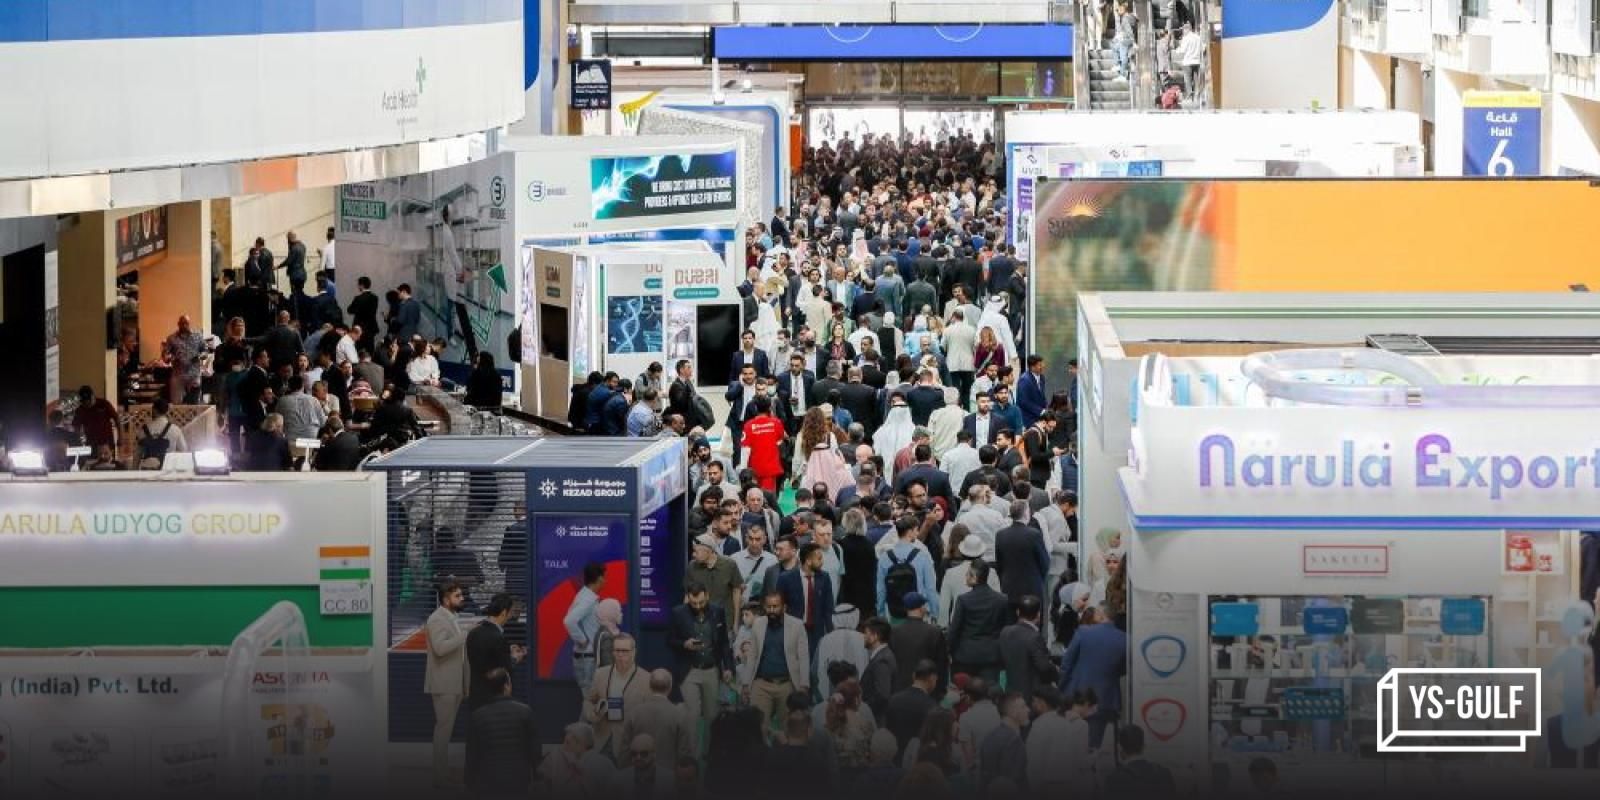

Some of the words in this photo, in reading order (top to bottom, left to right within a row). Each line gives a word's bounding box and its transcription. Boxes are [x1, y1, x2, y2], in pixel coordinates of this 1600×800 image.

[1490, 126, 1513, 137] Hall
[1487, 138, 1514, 177] 6
[562, 489, 592, 497] KEZAD
[594, 489, 626, 497] GROUP
[93, 513, 182, 535] UDYOG
[191, 513, 281, 535] GROUP
[544, 559, 569, 569] TALK
[11, 675, 80, 697] (India)
[88, 677, 129, 695] Pvt.
[137, 676, 179, 695] Ltd.
